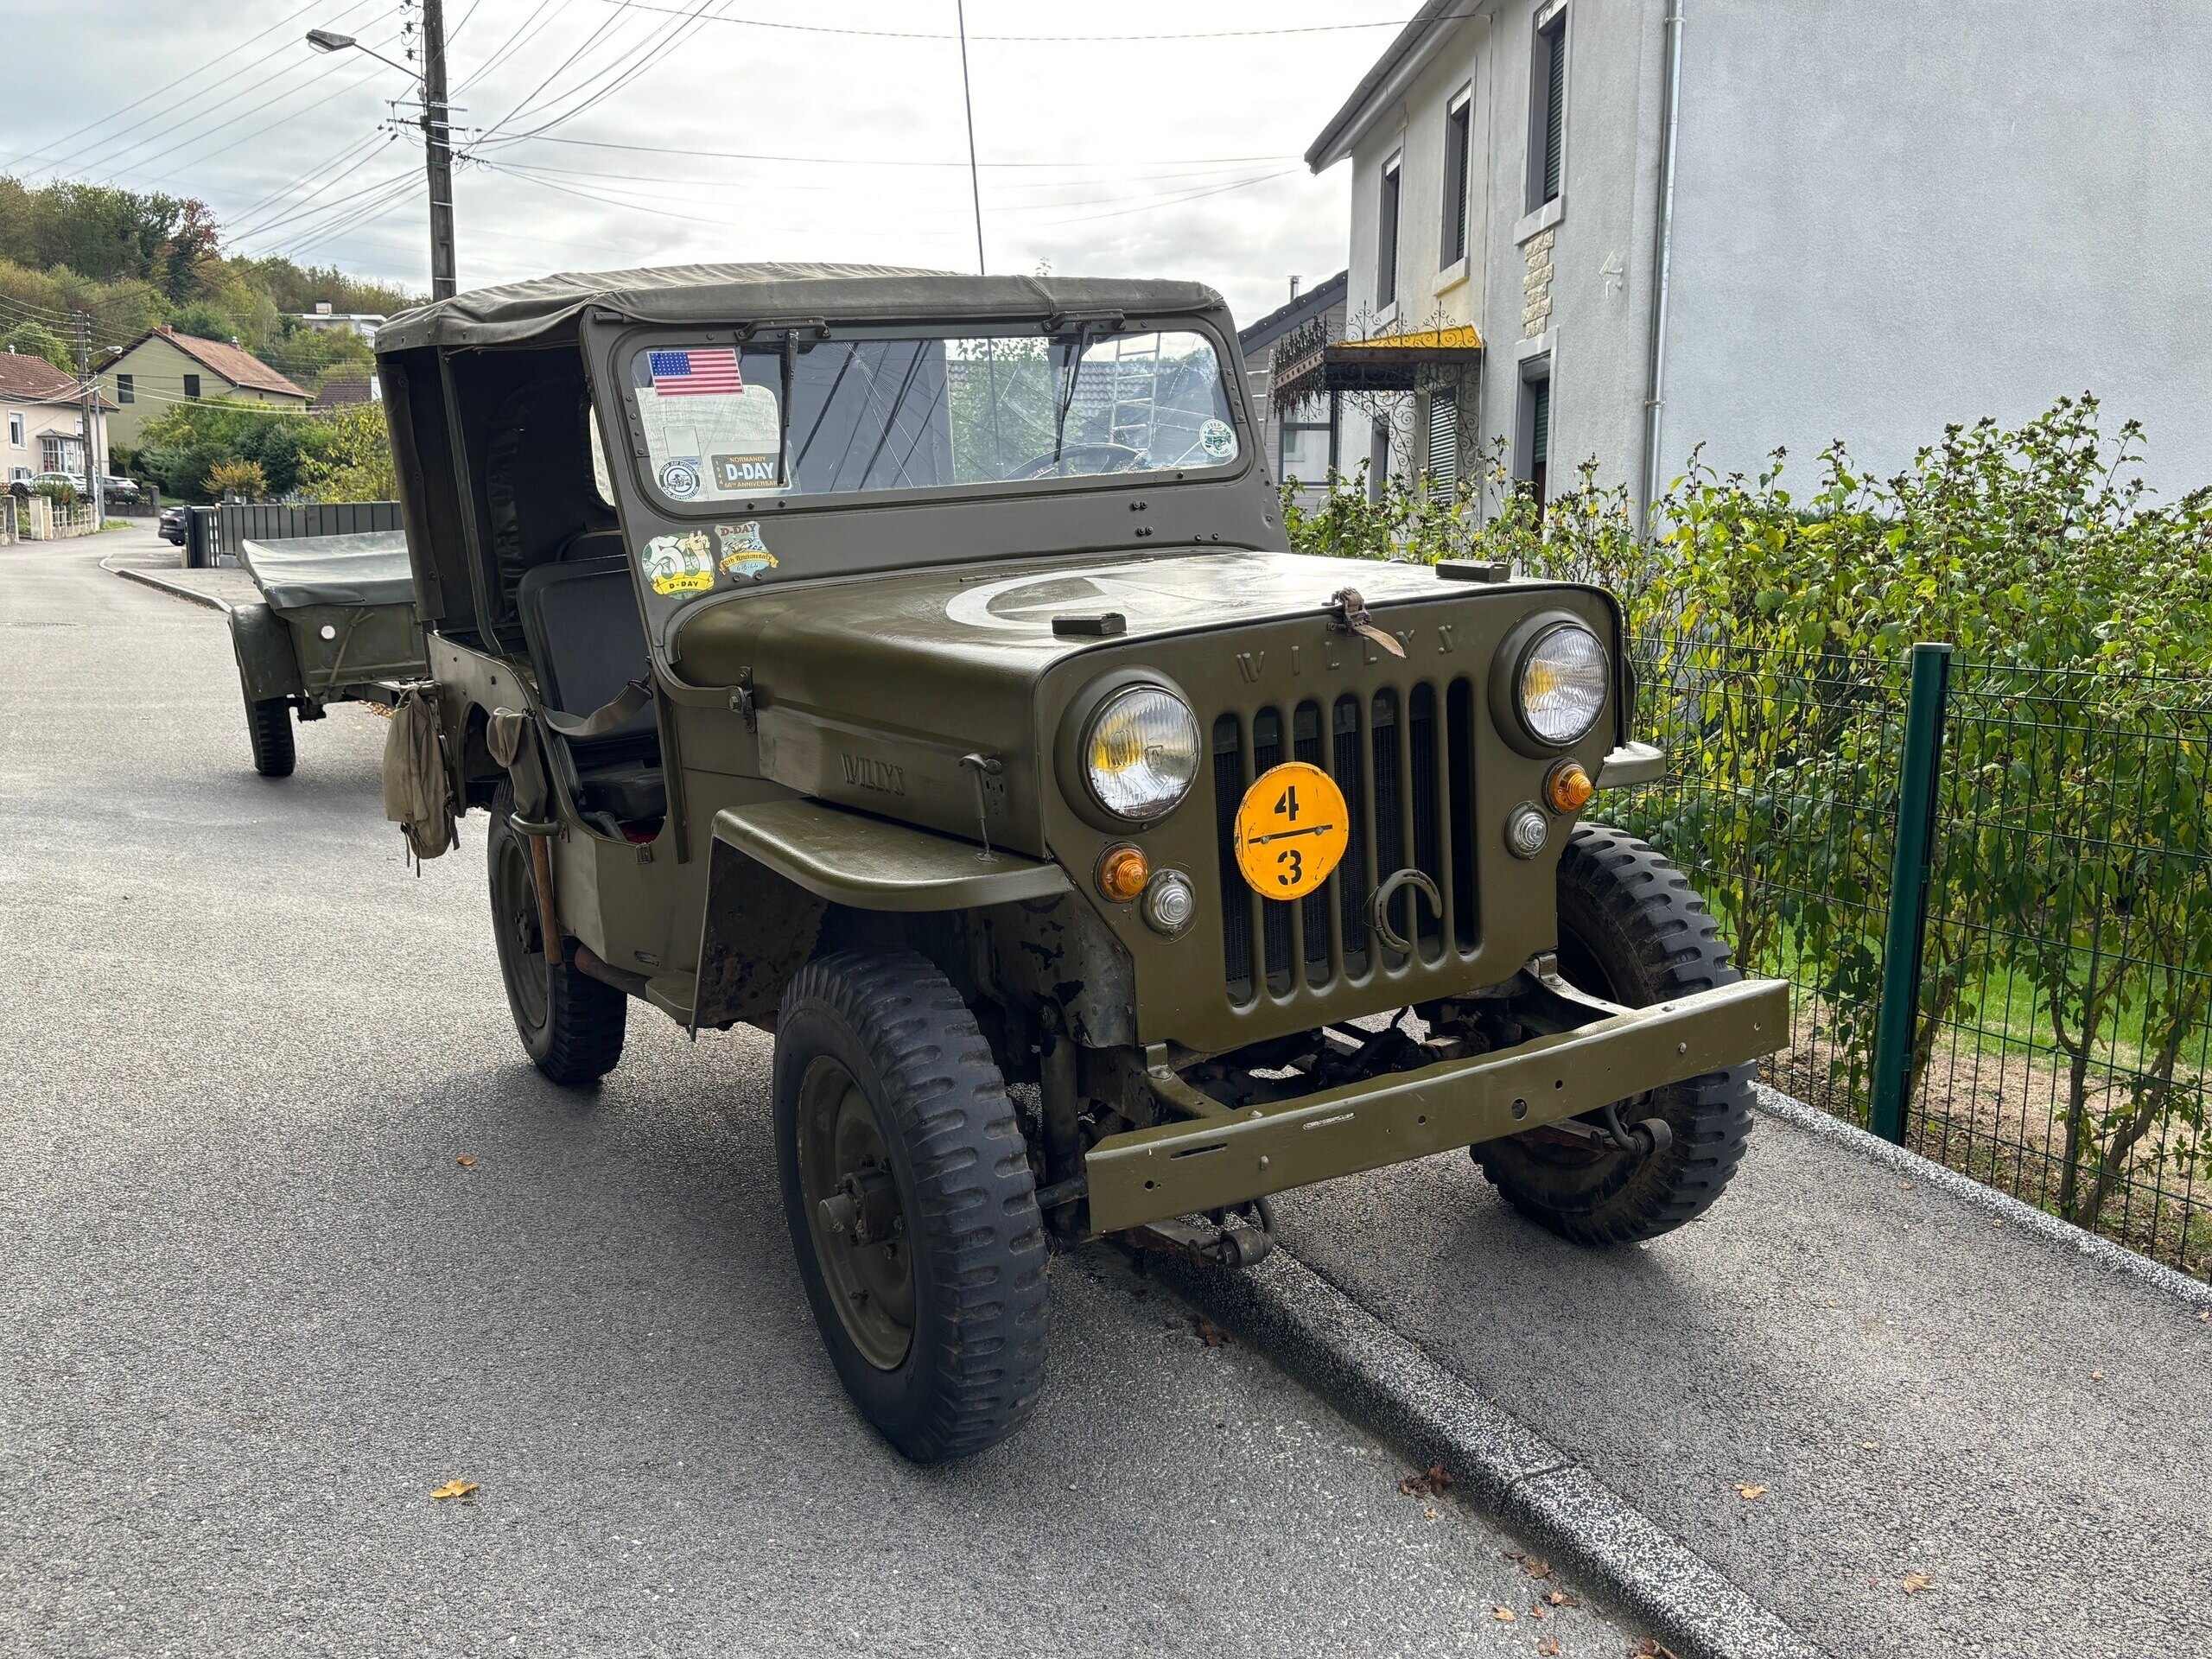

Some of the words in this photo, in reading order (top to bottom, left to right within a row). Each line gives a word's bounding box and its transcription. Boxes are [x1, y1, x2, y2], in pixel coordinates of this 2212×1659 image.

[725, 461, 774, 481] D-DAY
[736, 480, 779, 488] ANNIVERSAR
[720, 523, 757, 537] D-DAY
[669, 581, 699, 589] D-DAY
[1236, 624, 1453, 683] WILLYS
[841, 753, 906, 796] WILLYS
[1274, 785, 1300, 821] 4
[1277, 849, 1302, 886] 3
